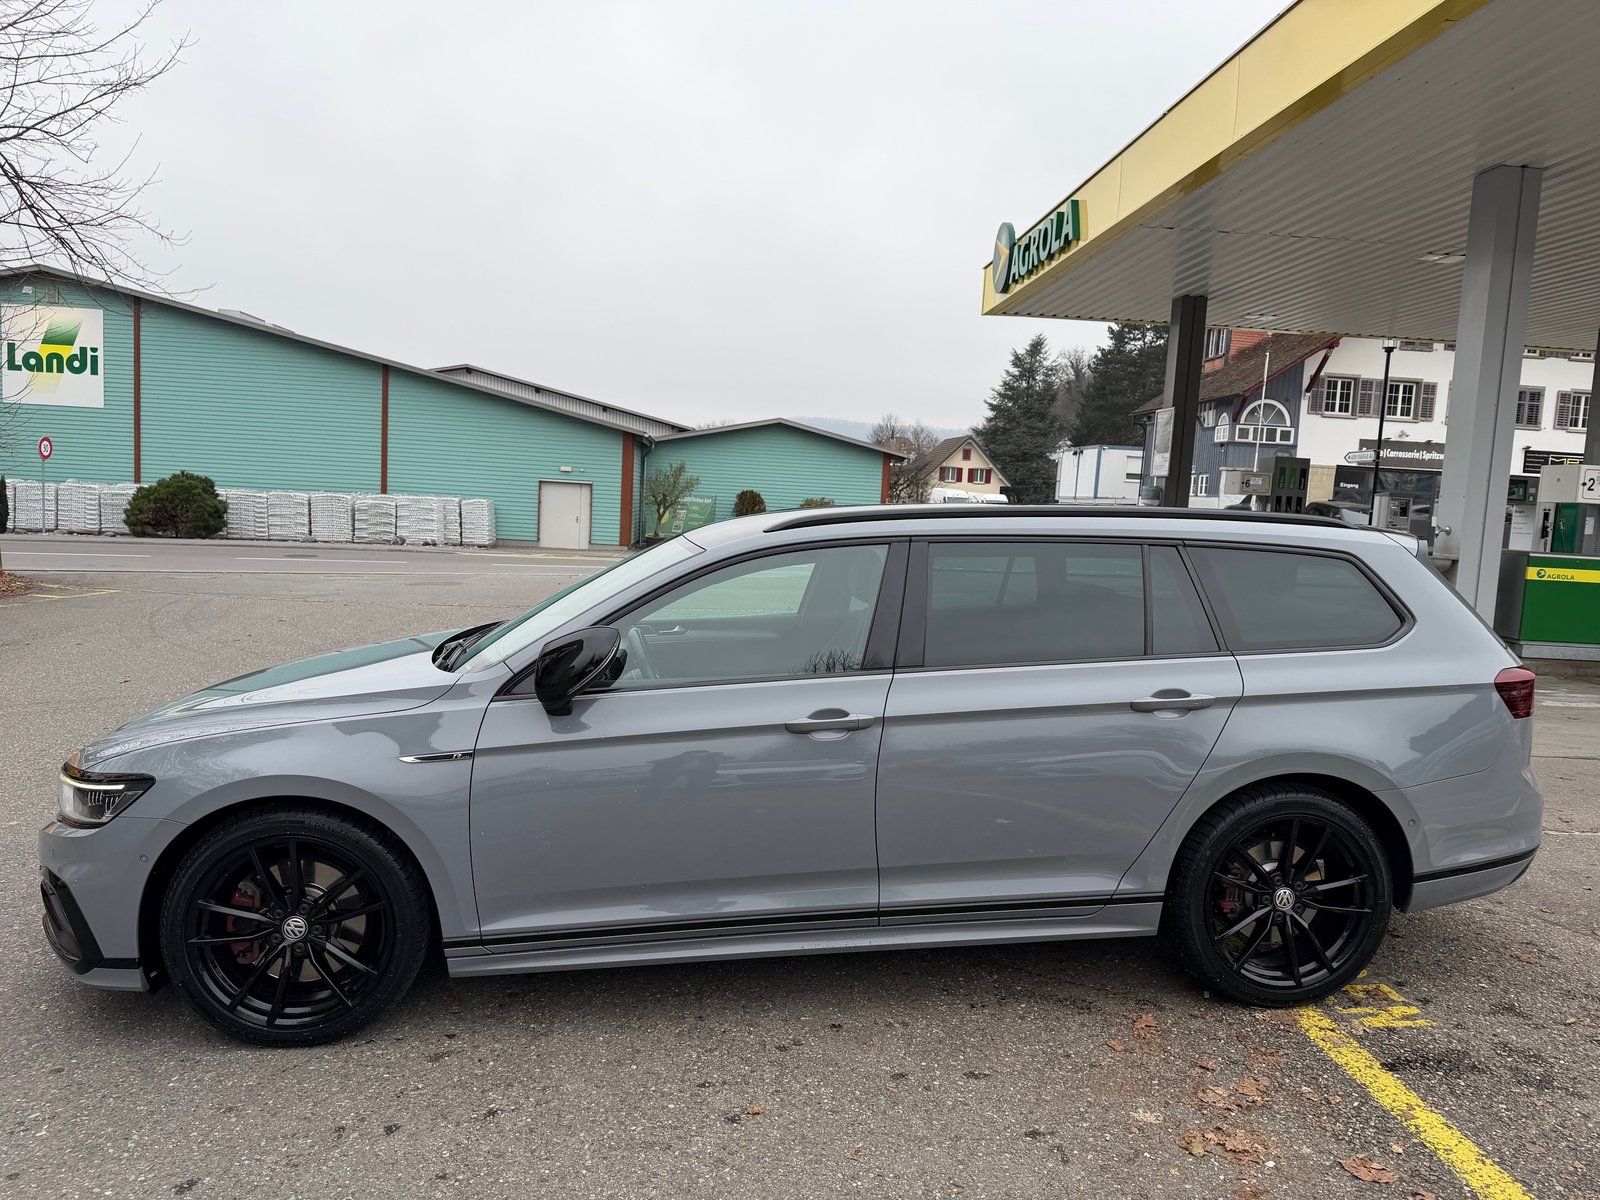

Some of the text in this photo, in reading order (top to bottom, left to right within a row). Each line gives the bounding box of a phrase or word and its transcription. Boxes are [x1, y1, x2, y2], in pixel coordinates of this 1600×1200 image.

[1009, 199, 1080, 285] AGROLA
[7, 342, 99, 376] Landi
[1245, 479, 1251, 488] 6
[1587, 477, 1596, 491] 2
[1546, 573, 1575, 581] AGROLA
